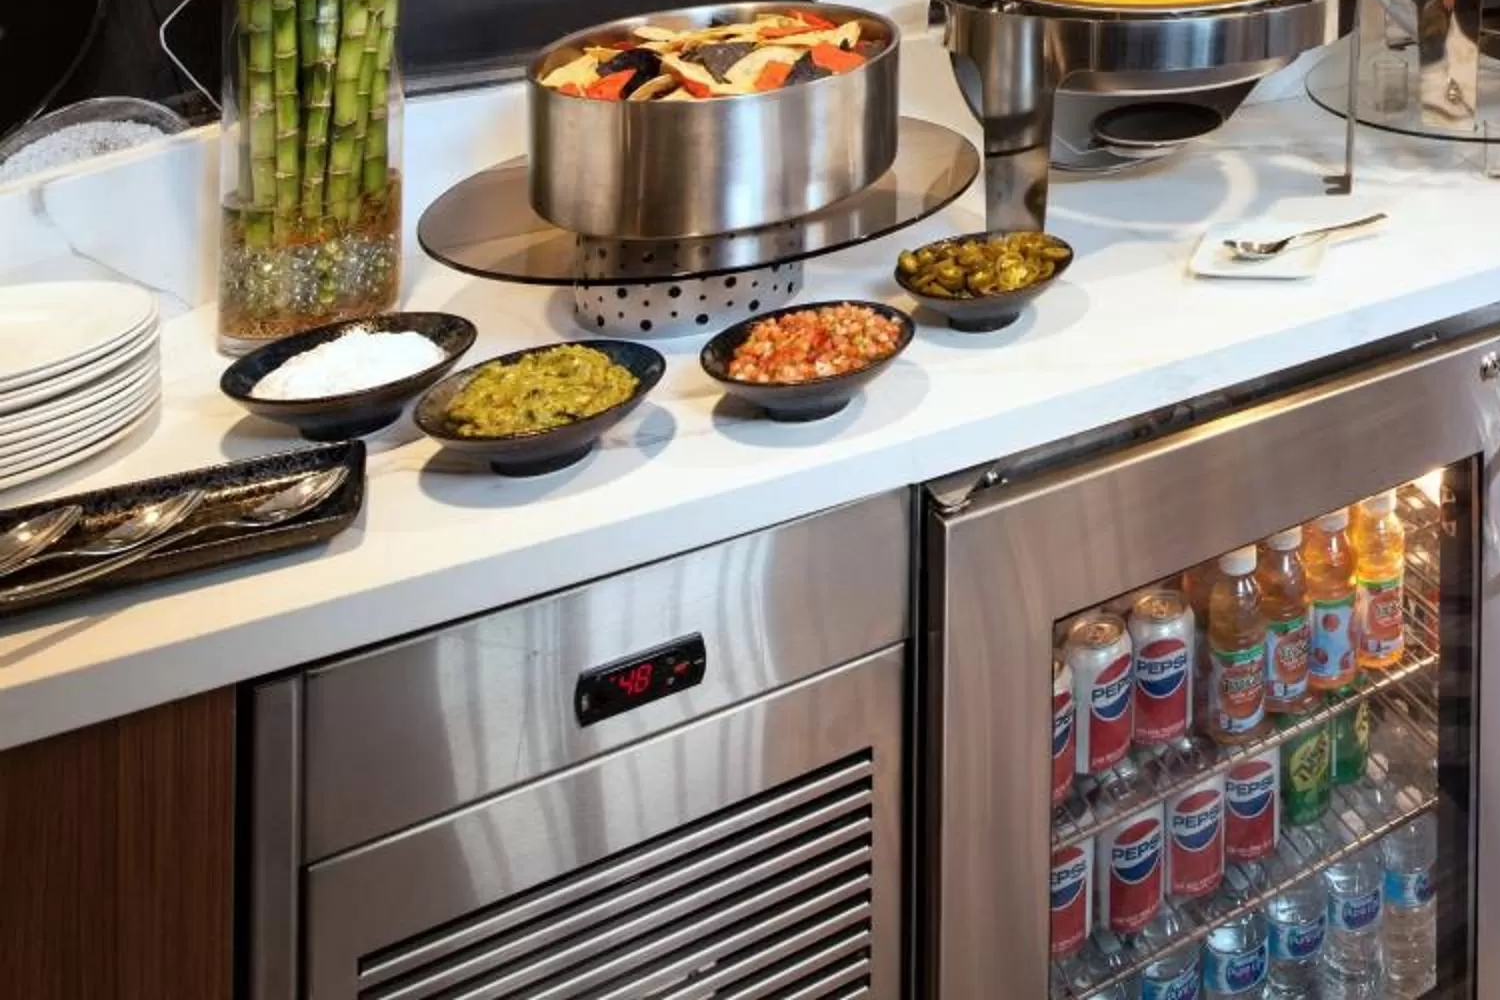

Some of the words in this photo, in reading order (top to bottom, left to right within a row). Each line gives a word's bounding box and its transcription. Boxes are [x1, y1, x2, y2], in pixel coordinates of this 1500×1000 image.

[1136, 654, 1187, 675] PEPS
[1091, 677, 1132, 702] PEP
[1225, 775, 1275, 797] PEPS
[1172, 803, 1221, 829] PEPS
[1112, 833, 1161, 862] PEPS
